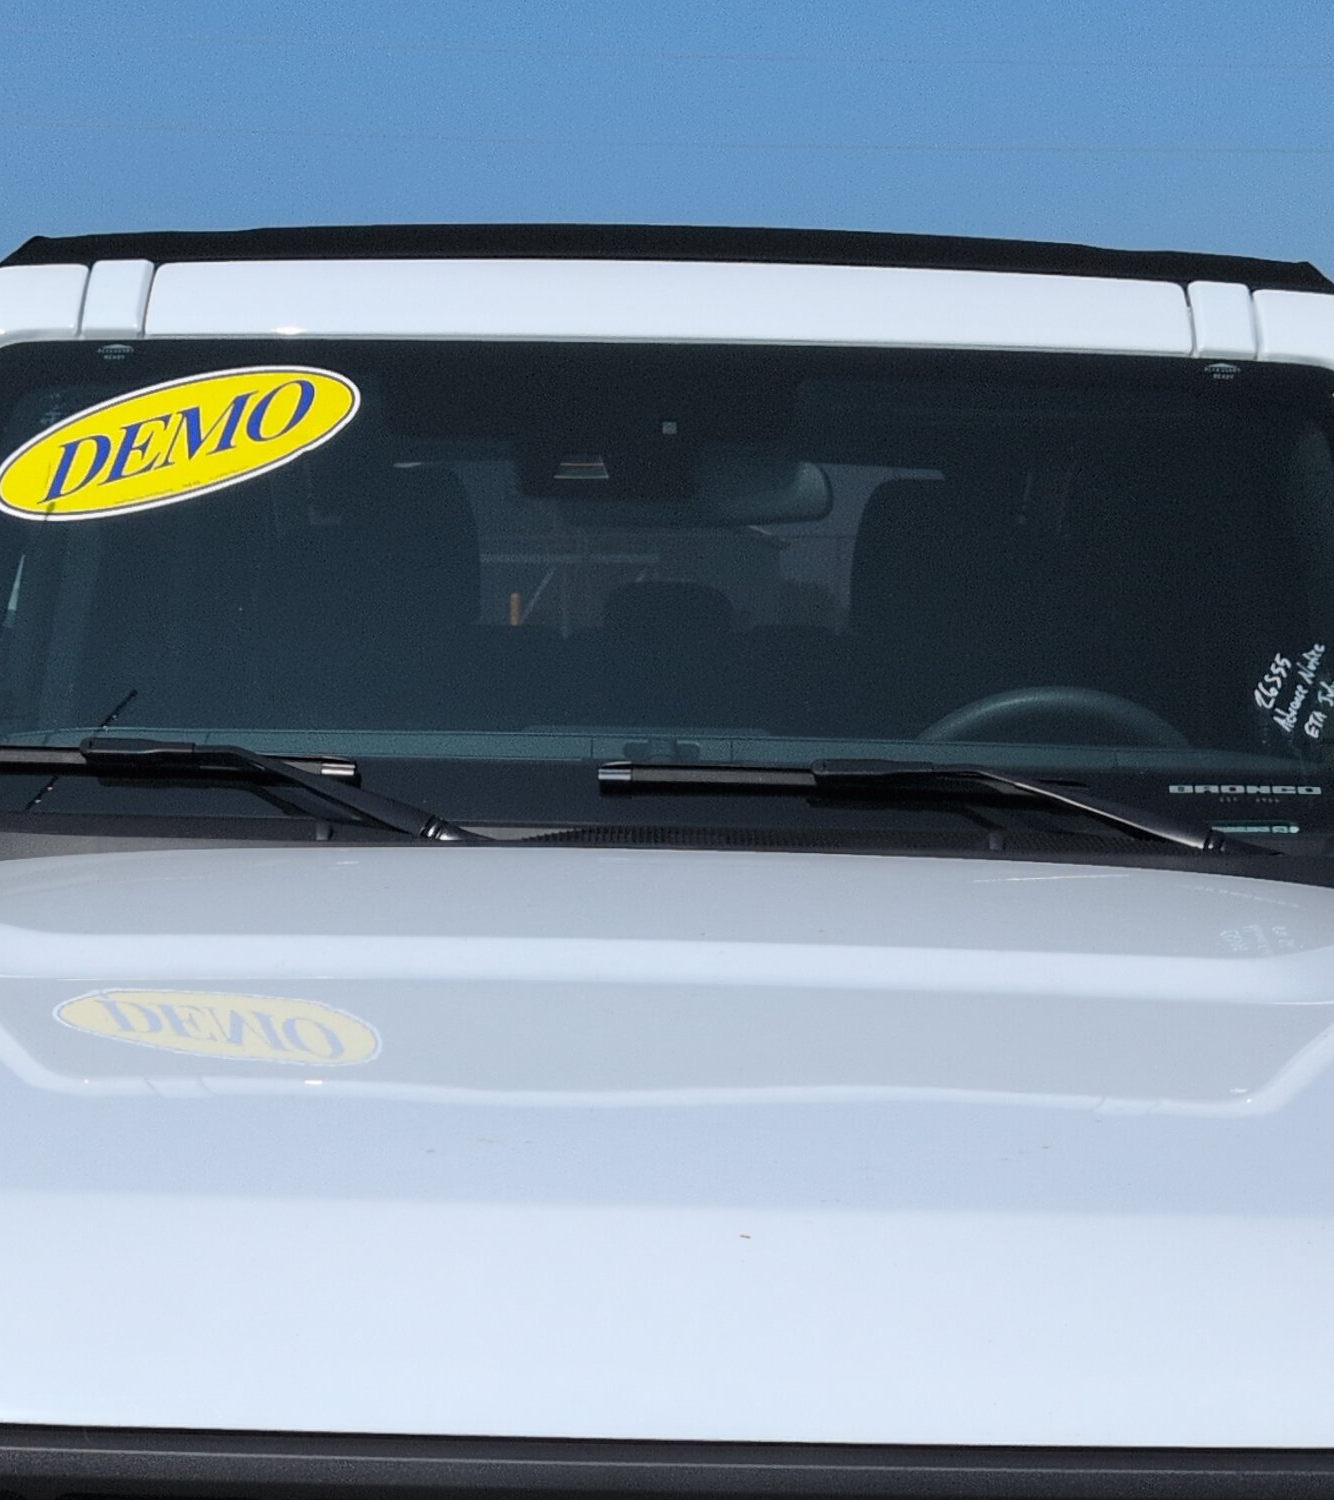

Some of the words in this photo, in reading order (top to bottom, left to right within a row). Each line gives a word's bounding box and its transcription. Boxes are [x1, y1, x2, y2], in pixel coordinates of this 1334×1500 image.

[36, 379, 316, 504] DEMO
[1304, 710, 1328, 739] ETA
[1169, 784, 1322, 795] BRONCO
